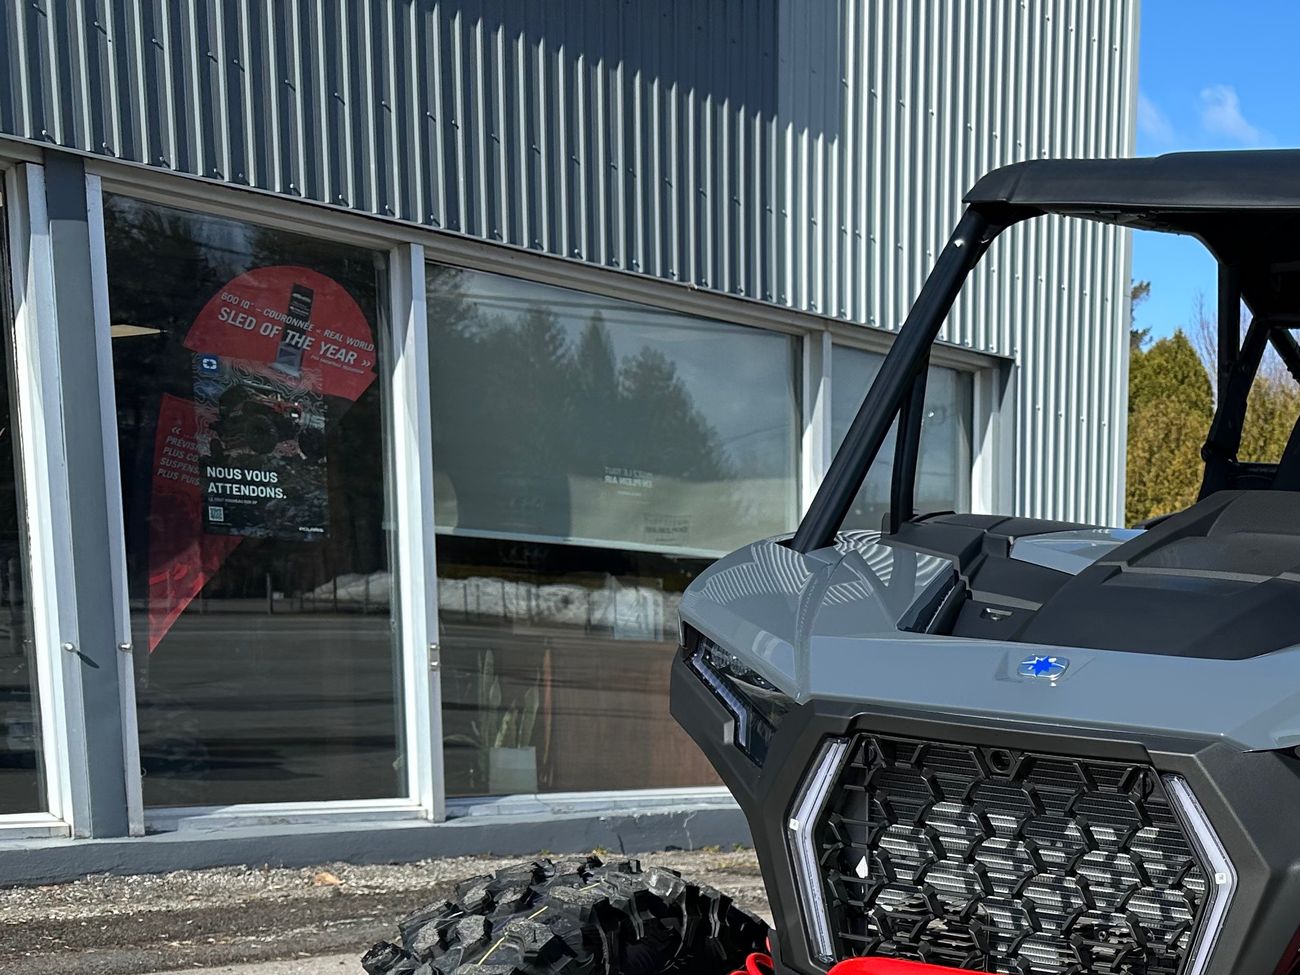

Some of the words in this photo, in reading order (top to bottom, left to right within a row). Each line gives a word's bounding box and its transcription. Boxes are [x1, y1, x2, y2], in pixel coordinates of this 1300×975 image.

[218, 307, 257, 330] SLED
[260, 322, 282, 338] OF
[285, 330, 315, 350] THE
[319, 341, 357, 364] YEAR
[263, 308, 315, 332] COURONNÉE
[323, 329, 344, 342] REAL
[346, 336, 375, 352] WORLD
[160, 457, 200, 475] SUSPENS
[206, 466, 242, 480] NOUS
[245, 469, 278, 483] VOUS
[207, 482, 287, 499] ATTENDONS.
